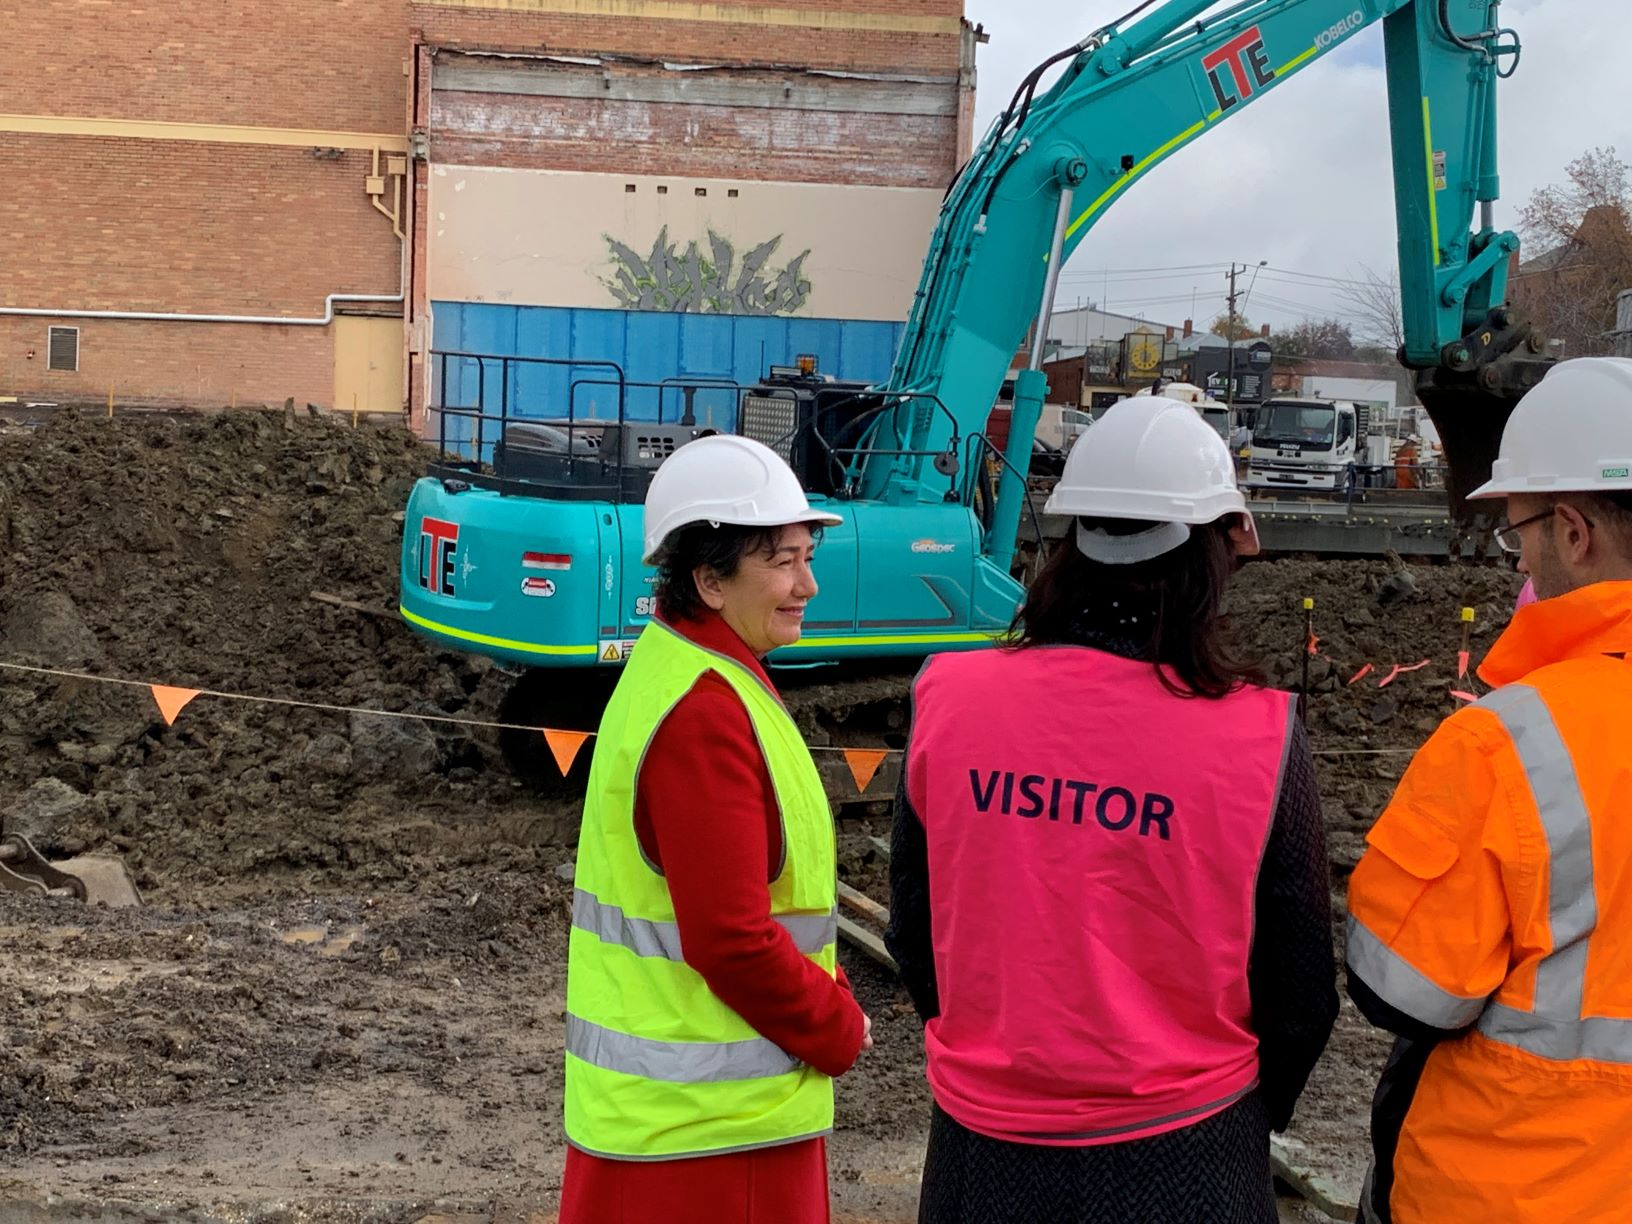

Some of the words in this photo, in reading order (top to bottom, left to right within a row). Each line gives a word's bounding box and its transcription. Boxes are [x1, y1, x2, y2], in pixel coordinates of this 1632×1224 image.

[1201, 24, 1276, 112] LTE
[1313, 10, 1364, 50] KOBELCO
[420, 516, 460, 598] LTE
[969, 769, 1174, 841] VISITOR
